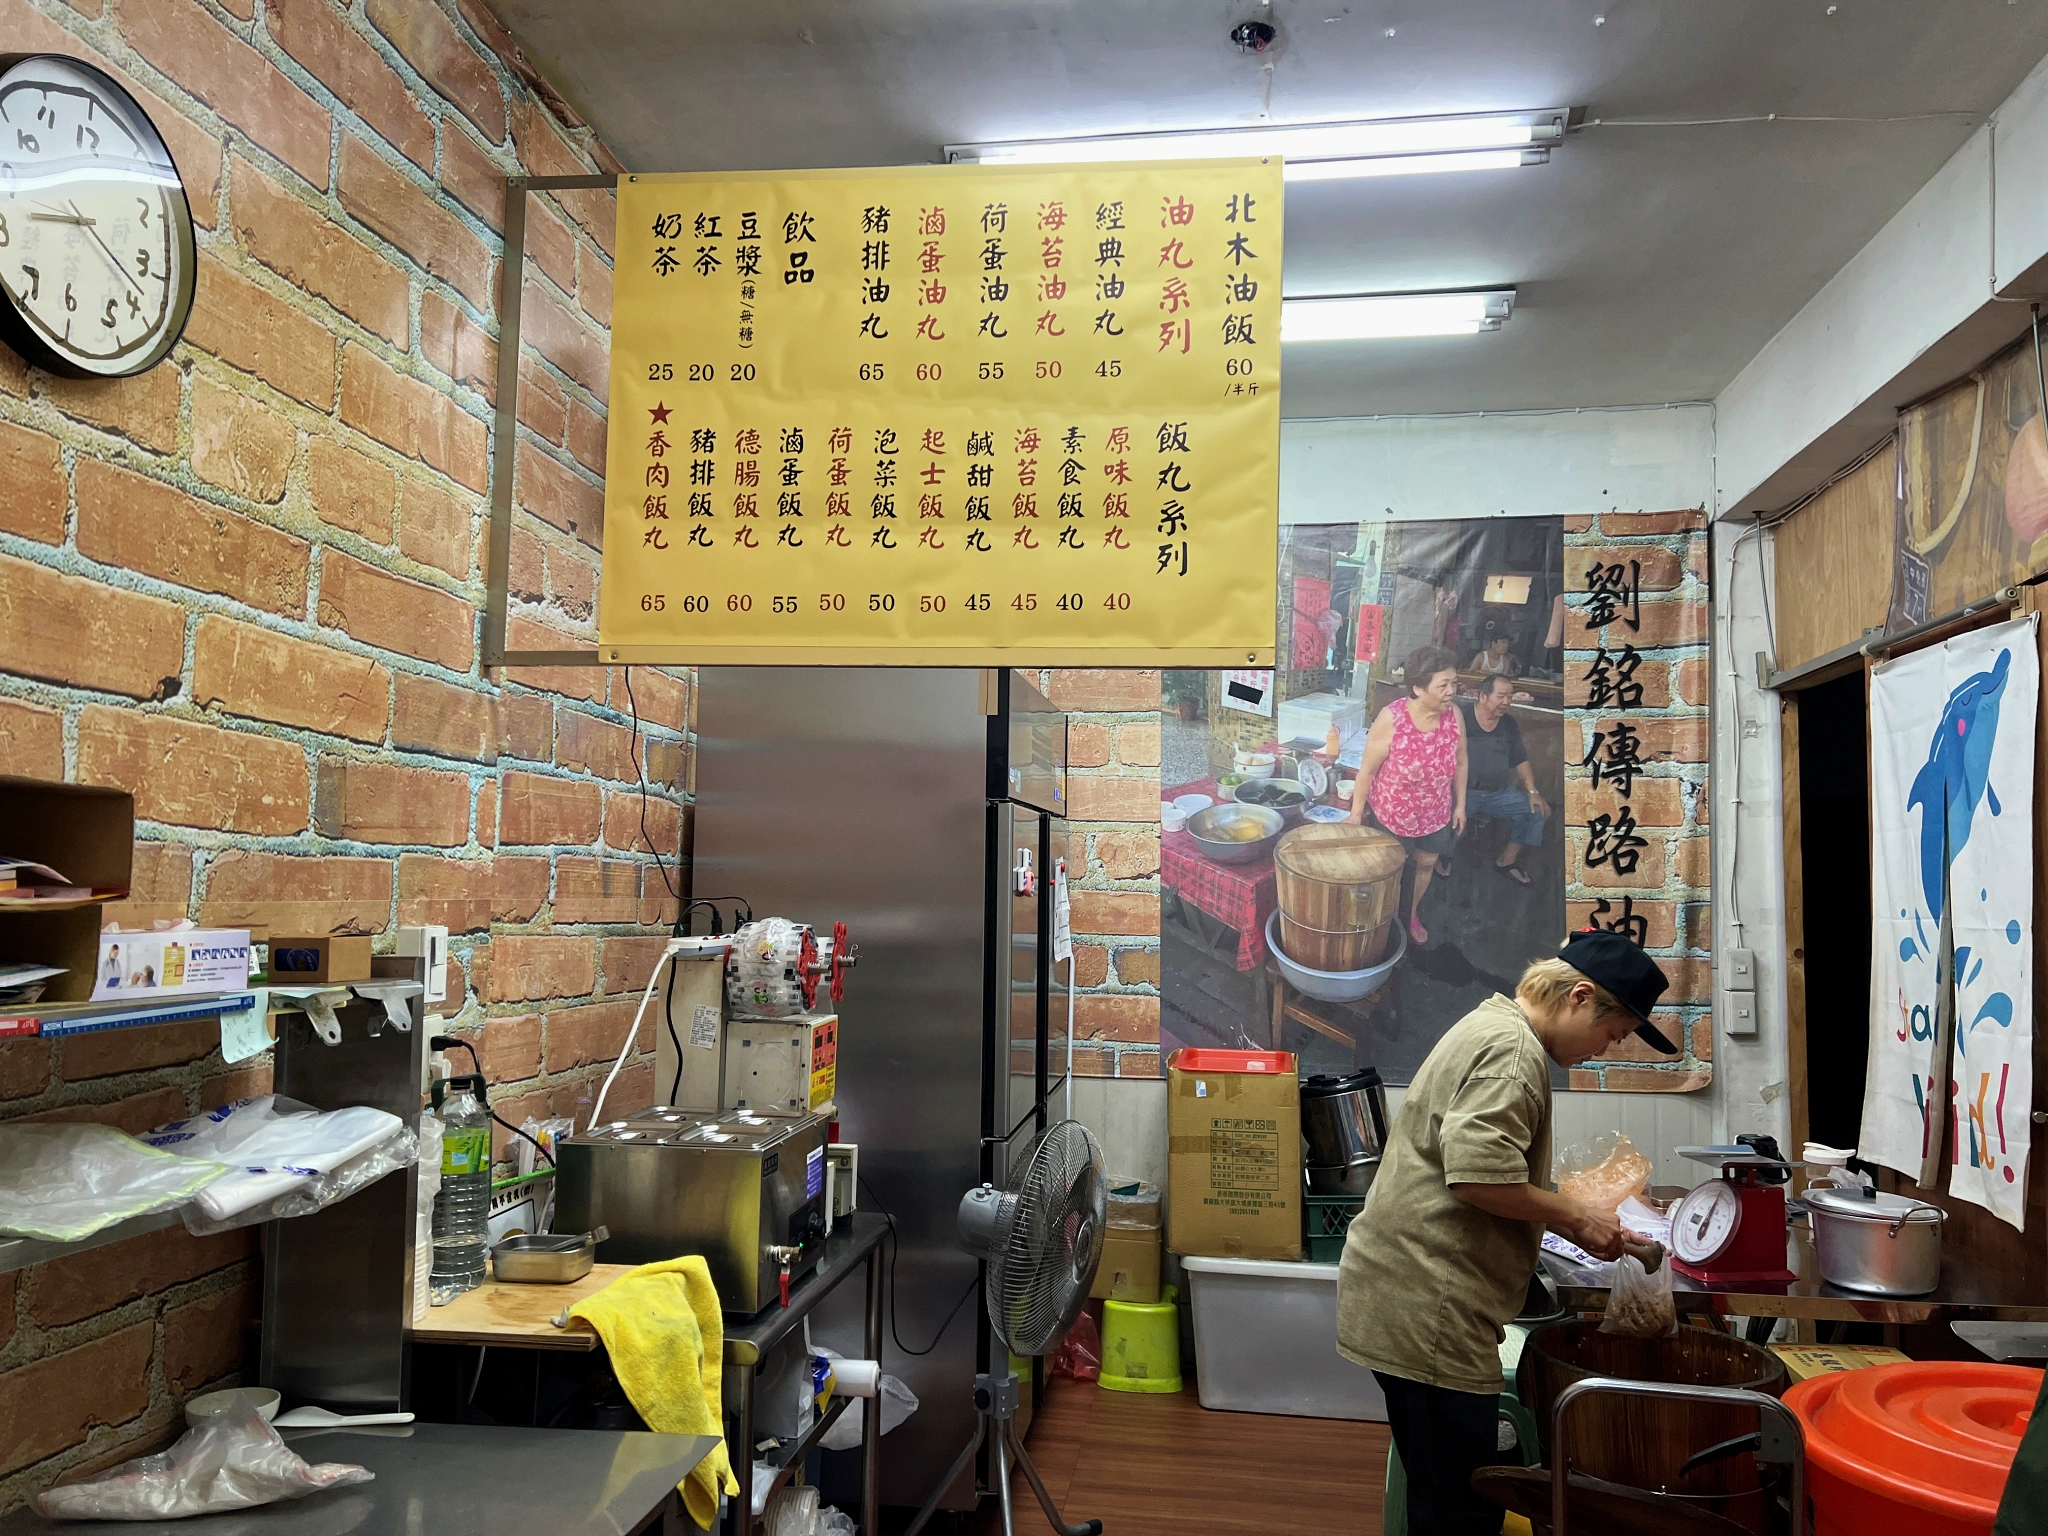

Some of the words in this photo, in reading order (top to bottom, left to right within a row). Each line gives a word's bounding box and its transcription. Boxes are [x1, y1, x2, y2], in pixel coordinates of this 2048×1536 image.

[37, 105, 56, 130] 11
[76, 124, 99, 158] 12
[136, 197, 150, 229] 2
[652, 213, 681, 277] 奶茶
[693, 212, 722, 276] 紅茶
[782, 211, 816, 285] 飲品
[136, 248, 150, 277] 3
[859, 205, 891, 339] 豬排油丸
[916, 206, 946, 340] 滷蛋油丸
[978, 203, 1008, 338] 荷蛋油丸
[1035, 201, 1067, 336] 海苔油丸
[1093, 201, 1125, 335] 經典油丸
[1158, 195, 1194, 354] 油丸系列
[1222, 193, 1258, 345] 北木油飯
[22, 264, 40, 301] 7
[64, 282, 78, 312] 6
[100, 298, 119, 329] 5
[125, 289, 141, 320] 4
[649, 364, 673, 380] 25
[689, 364, 714, 381] 20
[731, 364, 755, 381] 20
[860, 364, 884, 380] 65
[917, 364, 941, 380] 60
[979, 362, 1004, 379] 55
[1036, 361, 1061, 378] 50
[1095, 360, 1121, 377] 45
[1226, 359, 1252, 375] 60
[643, 430, 672, 549] 香肉飯丸
[687, 428, 716, 547] 豬排飯丸
[733, 428, 762, 548] 德腸飯丸
[777, 427, 804, 547] 滷蛋飯丸
[825, 427, 852, 547] 荷蛋飯丸
[871, 428, 899, 548] 泡菜飯丸
[918, 428, 946, 549] 起士飯丸
[965, 431, 994, 552] 鹹甜飯丸
[1012, 427, 1041, 549] 海苔飯丸
[1057, 426, 1086, 549] 素食飯丸
[1103, 427, 1132, 549] 原味飯丸
[1156, 422, 1191, 576] 飯丸系列
[641, 595, 665, 611] 65
[684, 596, 708, 612] 60
[727, 595, 752, 611] 60
[773, 596, 797, 613] 55
[820, 594, 845, 611] 50
[869, 594, 895, 611] 50
[920, 596, 946, 612] 50
[965, 594, 990, 610] 45
[1011, 594, 1037, 610] 45
[1056, 593, 1083, 610] 40
[1103, 593, 1130, 610] 40
